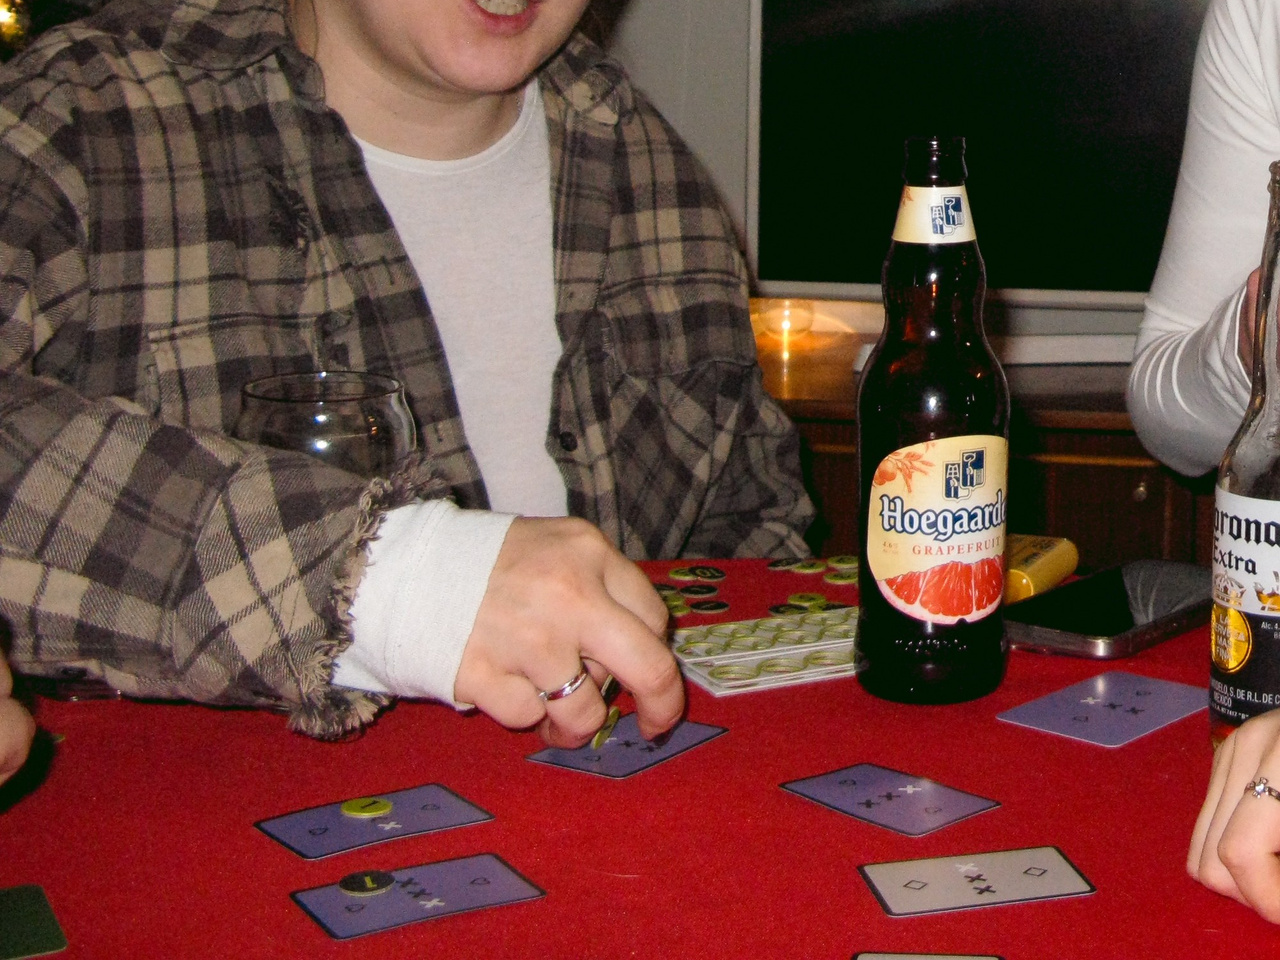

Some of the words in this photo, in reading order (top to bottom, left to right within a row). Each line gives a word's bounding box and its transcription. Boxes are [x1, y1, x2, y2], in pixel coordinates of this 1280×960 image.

[912, 536, 1001, 556] GRAPEFRUIT
[1213, 536, 1257, 575] Extra
[1261, 621, 1274, 630] Alc.
[1236, 688, 1246, 700] DE
[1262, 693, 1273, 704] DE
